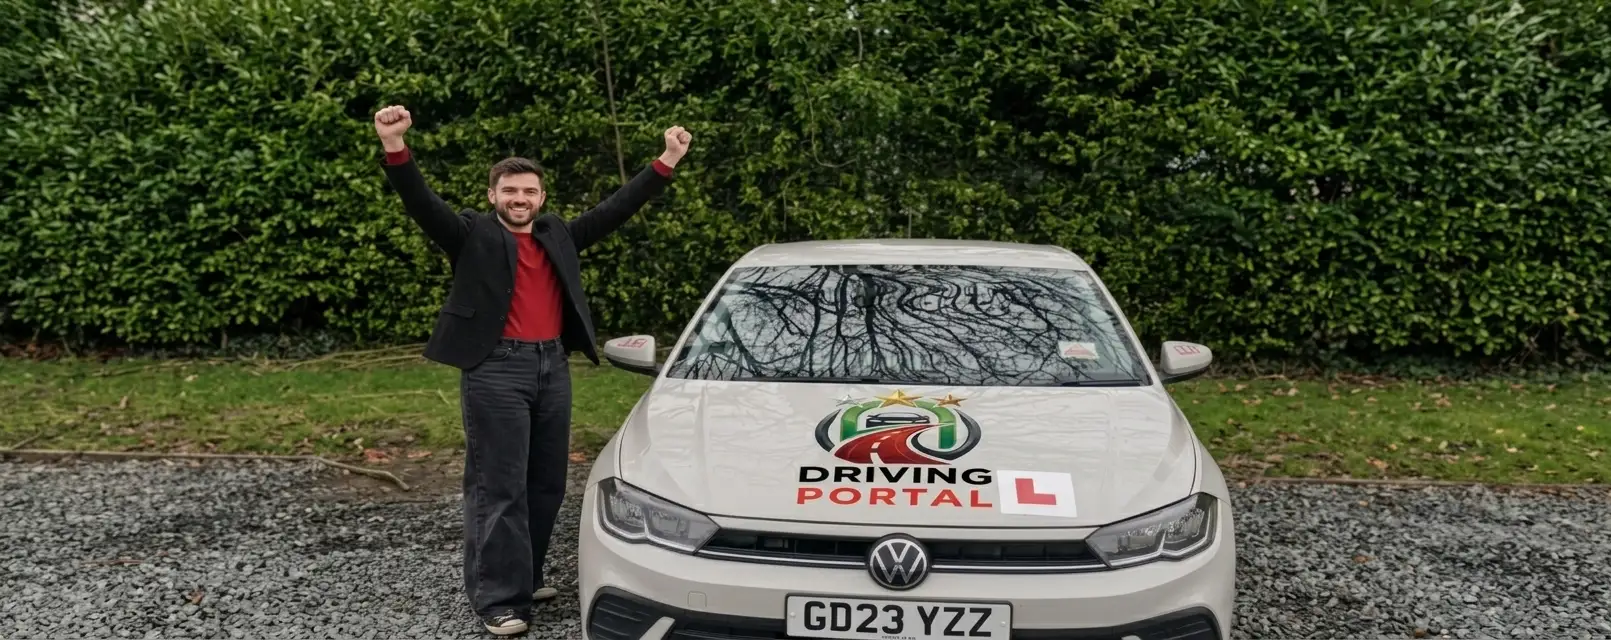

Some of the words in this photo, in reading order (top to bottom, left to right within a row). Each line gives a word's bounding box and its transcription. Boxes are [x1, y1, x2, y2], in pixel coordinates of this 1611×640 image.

[798, 466, 993, 485] DRIVING
[796, 487, 993, 508] PORTAL
[1015, 478, 1057, 506] L
[870, 539, 927, 588] VW
[804, 601, 905, 635] GD23
[917, 605, 993, 637] YZZ
